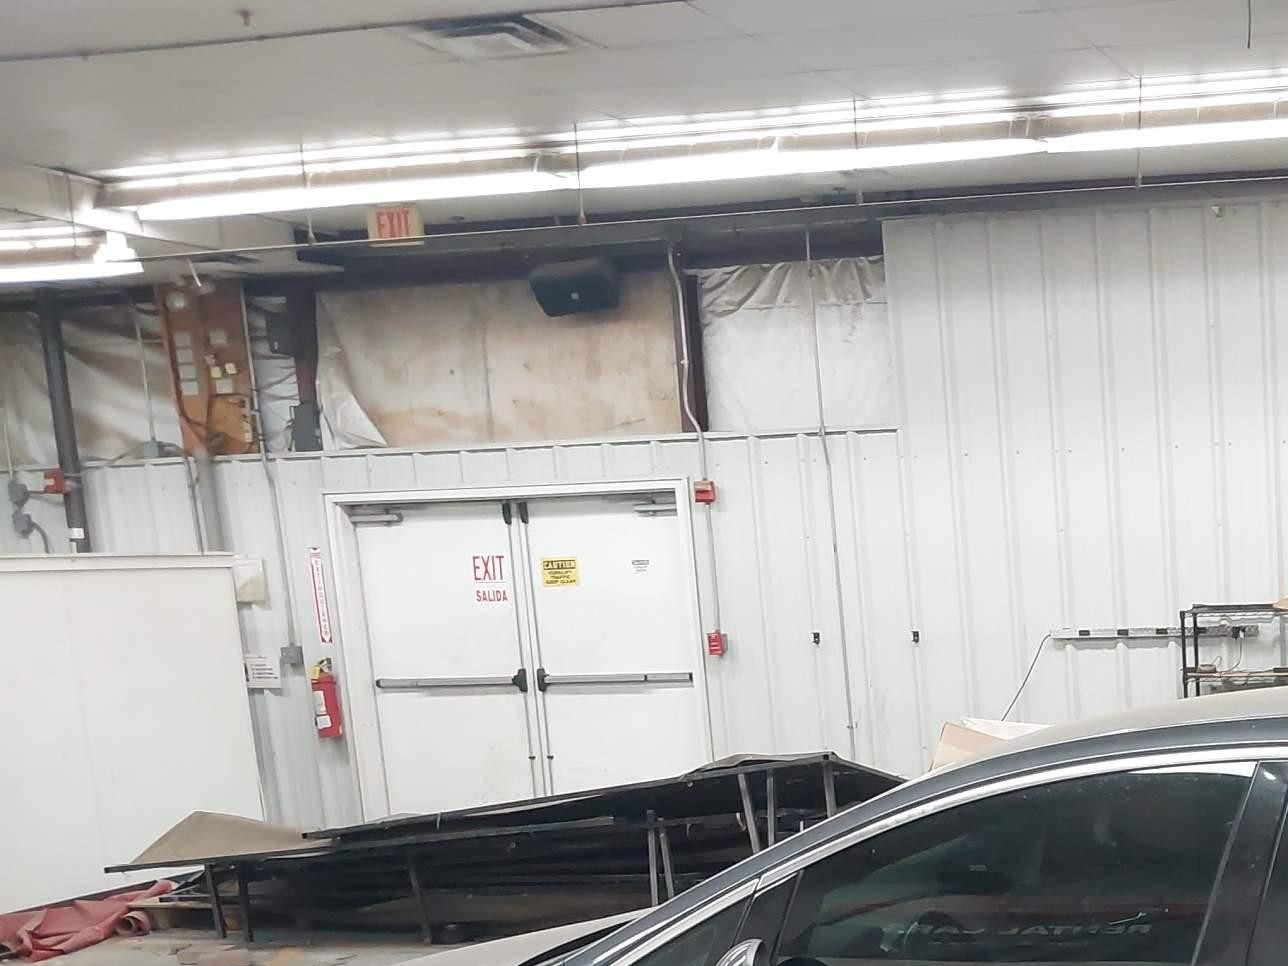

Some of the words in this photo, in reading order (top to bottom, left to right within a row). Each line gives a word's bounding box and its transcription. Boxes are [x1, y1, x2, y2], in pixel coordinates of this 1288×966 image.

[376, 210, 409, 239] EXIT
[472, 555, 505, 581] EXIT
[543, 560, 577, 569] CAUTION
[476, 590, 508, 602] SALIDA
